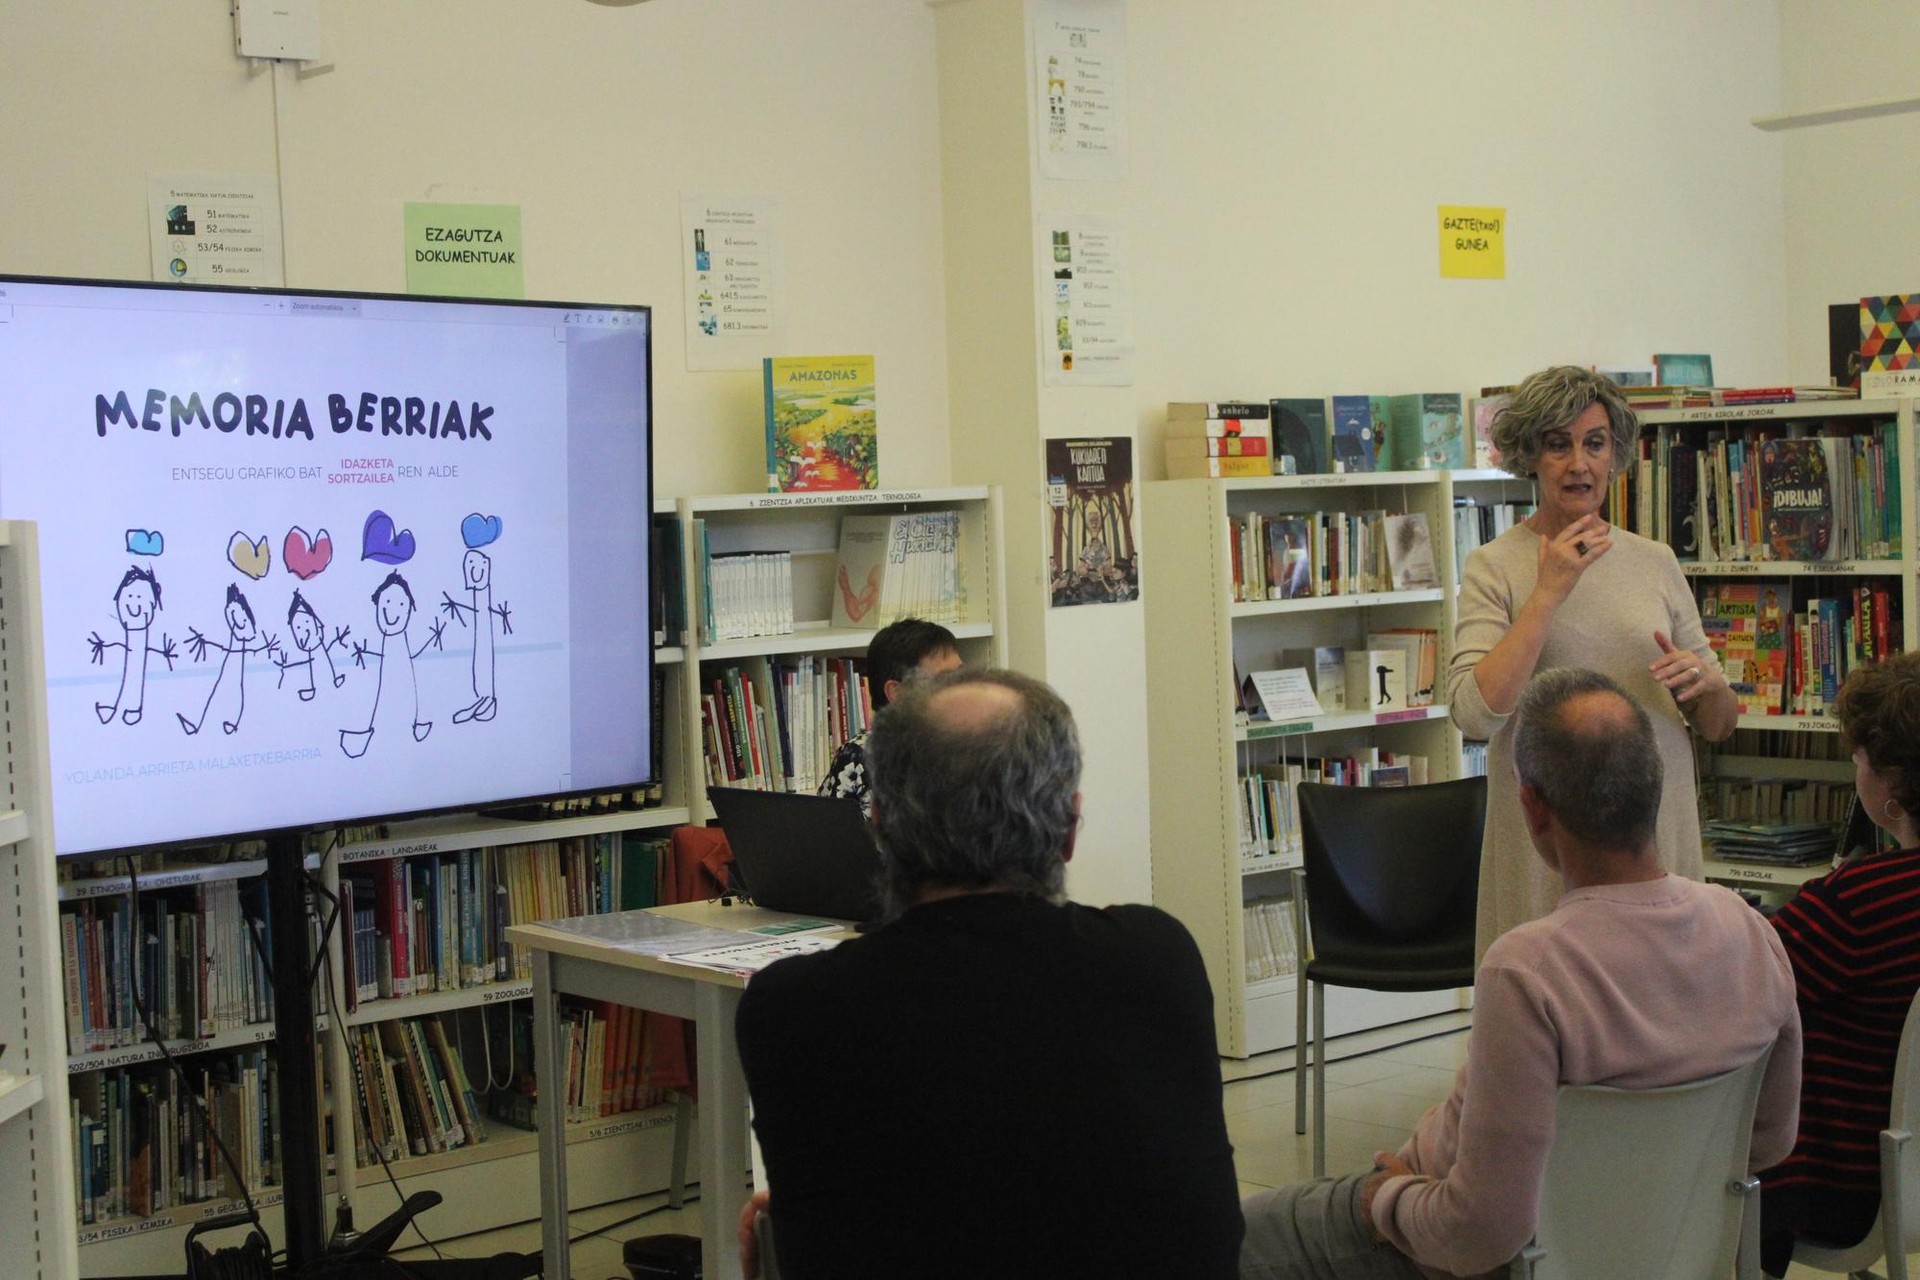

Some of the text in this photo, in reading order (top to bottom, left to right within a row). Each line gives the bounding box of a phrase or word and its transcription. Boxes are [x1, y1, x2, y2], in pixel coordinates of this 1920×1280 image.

[207, 210, 216, 219] 51
[206, 224, 217, 233] 52
[425, 227, 503, 243] EZAGUTZA
[197, 243, 224, 252] 53/54
[1455, 238, 1489, 251] GUNEA
[415, 249, 515, 264] DOKUMENTUAK
[212, 264, 223, 273] 55
[790, 370, 857, 382] AMAZONAS
[1866, 376, 1920, 387] COLORAM
[96, 388, 494, 441] MEMORIA BERRIAK
[1222, 407, 1250, 415] anhelo
[1690, 411, 1712, 419] ARTEA
[1715, 410, 1744, 418] KIROLAK
[1747, 408, 1775, 416] JOKOAK
[341, 458, 394, 469] IDAZKETA
[172, 466, 323, 481] ENTSEGU GRAFIKO BAT
[398, 465, 459, 478] REN ALDE
[328, 473, 395, 484] SORTZAILEA
[759, 499, 792, 507] ZIENTZIA
[795, 497, 833, 505] APLIKATUAK
[836, 495, 877, 503] MEDIKUNTZA
[882, 493, 921, 501] TEKNOLOGIA
[1773, 488, 1823, 509] ¡DIBUJA!
[1730, 565, 1759, 573] ZUMETA
[1718, 603, 1757, 616] ARTISTA
[65, 747, 322, 784] YOLANDA ARRIETA MALAXETXEBARRIA
[343, 843, 438, 860] BOTANIKA LANDAREAK
[1729, 868, 1774, 879] 796 KIROLAK
[76, 888, 87, 896] 39
[484, 993, 493, 1001] 59
[255, 1032, 265, 1040] 51
[107, 1054, 145, 1067] NATURA
[204, 1207, 215, 1217] 55
[101, 1225, 134, 1238] FISIKA
[139, 1218, 174, 1231] KIMIKA
